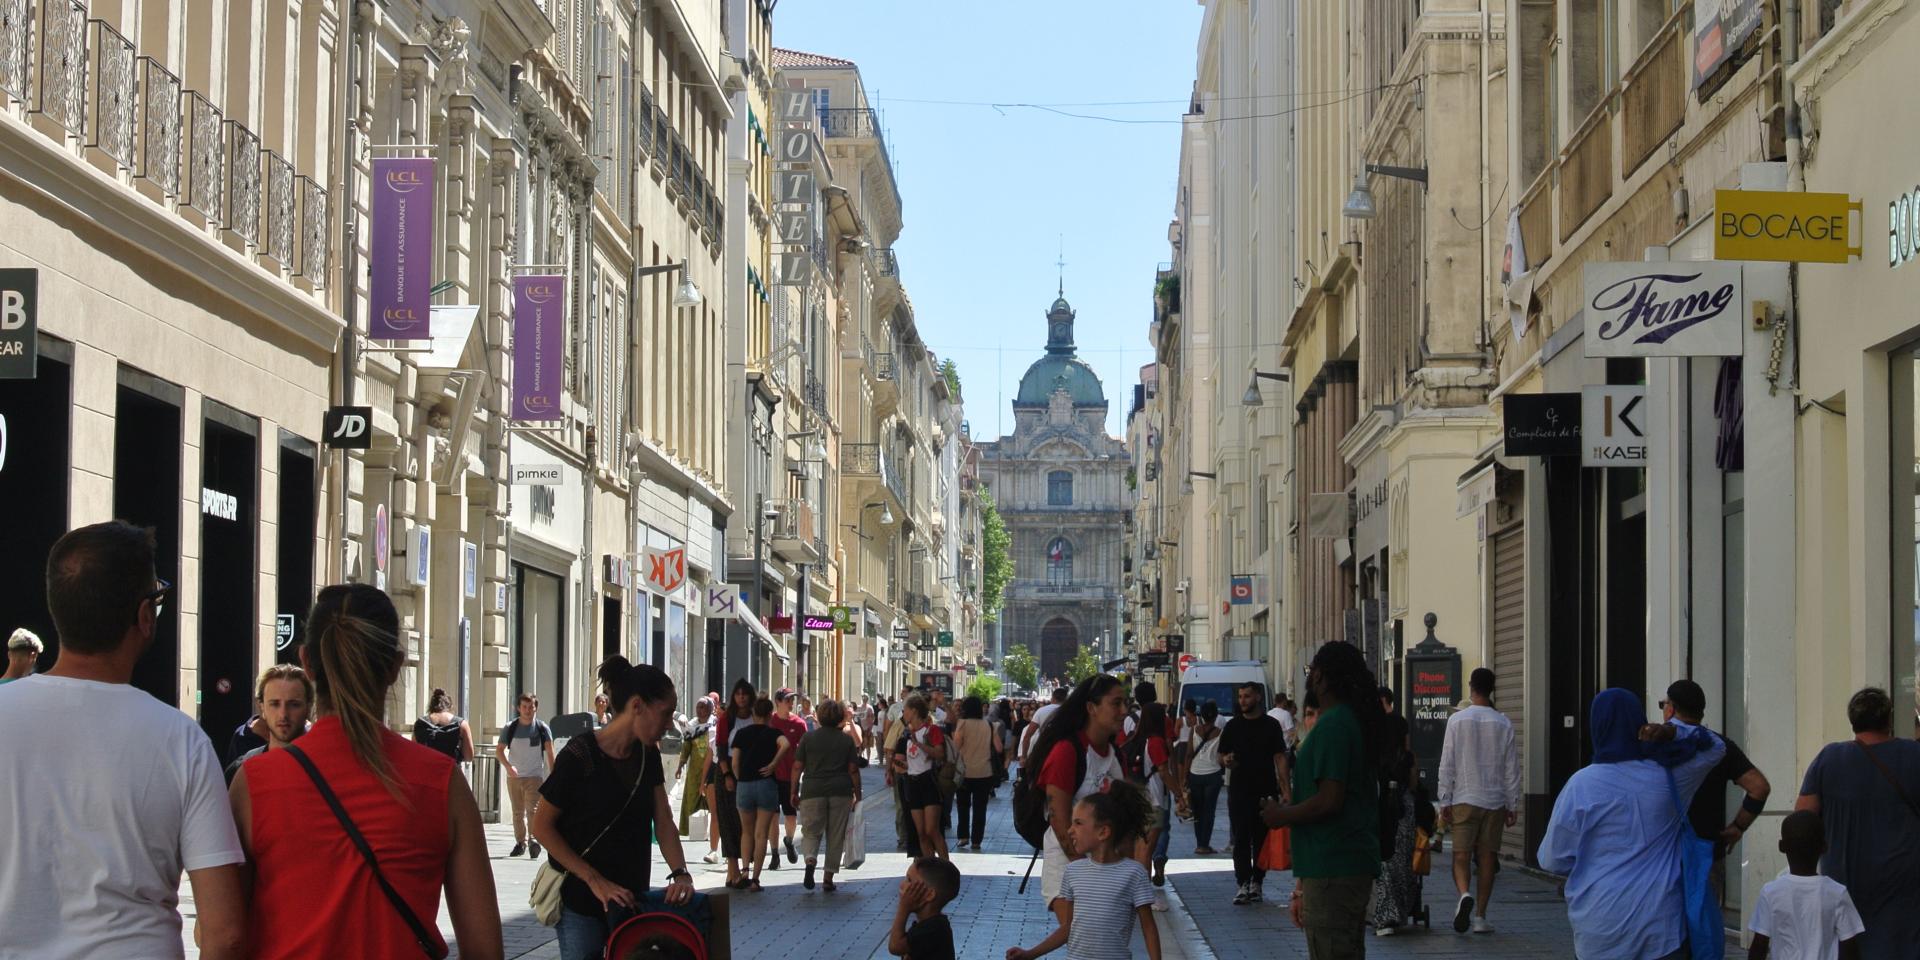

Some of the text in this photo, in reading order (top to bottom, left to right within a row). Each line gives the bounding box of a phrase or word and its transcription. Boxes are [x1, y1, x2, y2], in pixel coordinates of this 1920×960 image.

[389, 171, 420, 182] LCL
[786, 92, 809, 281] HOTEL
[1721, 212, 1843, 241] BOCAGE
[397, 198, 406, 303] BANQUE ET ASSURANCE
[528, 286, 551, 295] LCL
[386, 308, 416, 320] LCL
[1591, 272, 1734, 345] Fame
[0, 341, 23, 355] AR
[526, 396, 550, 405] LCL
[333, 415, 365, 438] JD
[1508, 426, 1556, 441] Complices
[1559, 427, 1569, 437] de
[517, 470, 558, 481] pimkie
[1418, 672, 1446, 682] Phone
[1413, 684, 1451, 694] Discount
